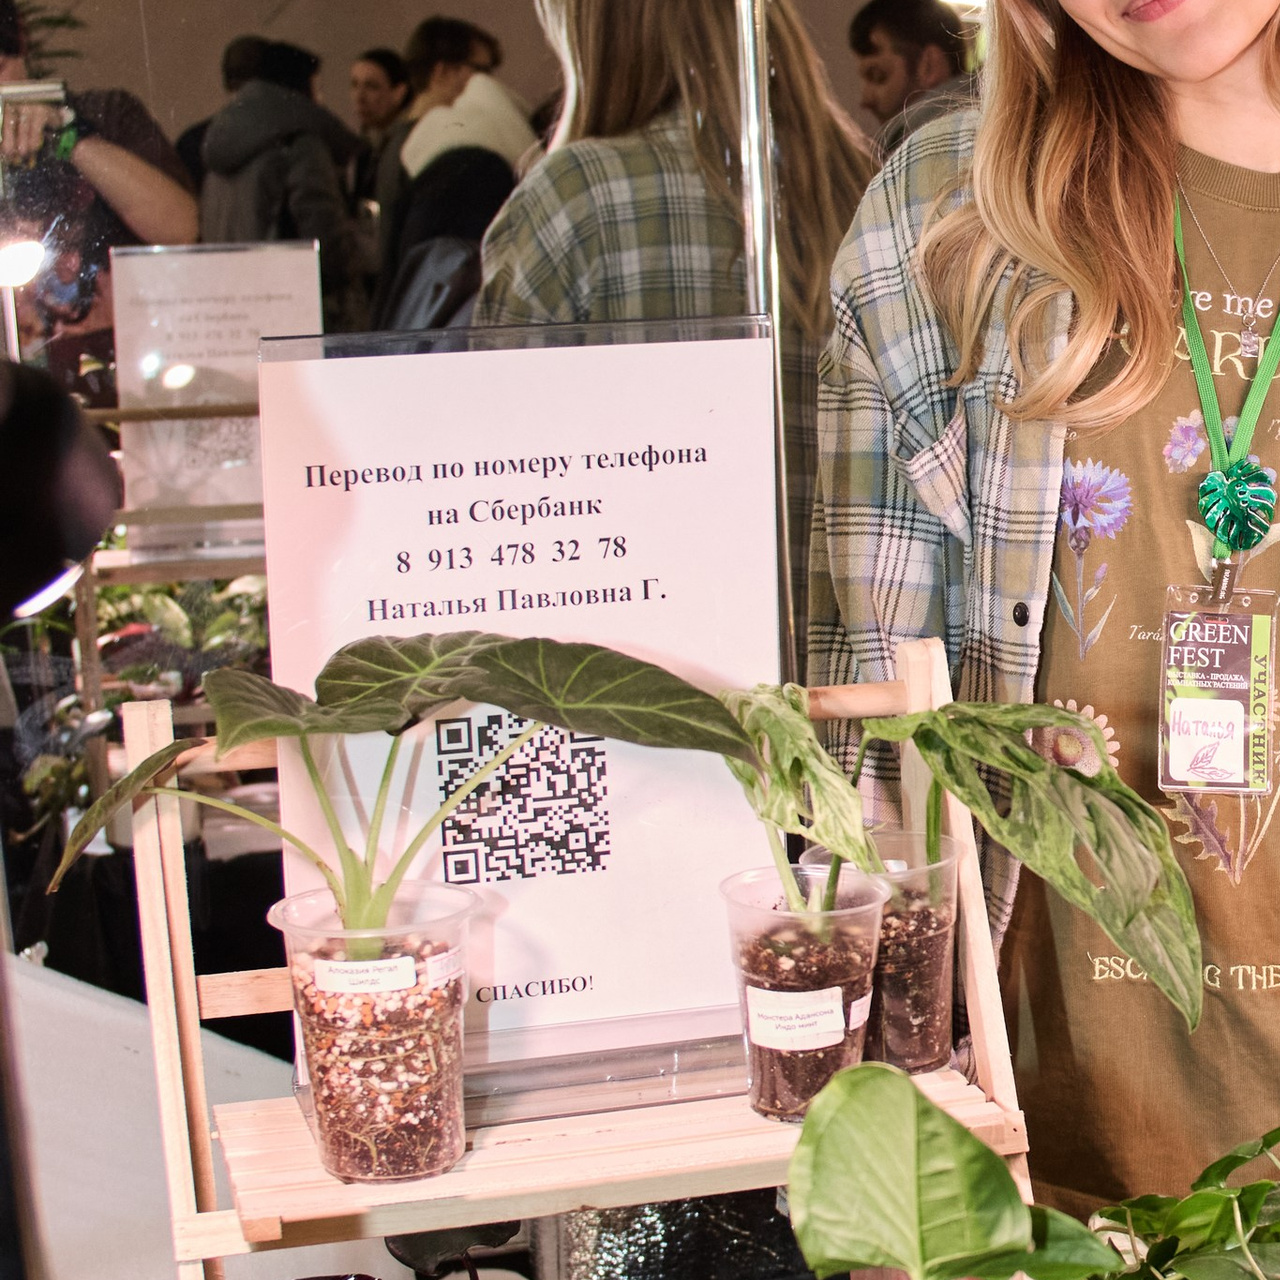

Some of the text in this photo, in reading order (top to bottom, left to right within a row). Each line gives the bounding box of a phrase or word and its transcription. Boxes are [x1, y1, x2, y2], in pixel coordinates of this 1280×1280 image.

[1223, 293, 1273, 319] me
[304, 444, 708, 492] Перевод по номеру телефона
[427, 495, 603, 526] на Сбербанк
[396, 535, 627, 574] 8 913 478 32 78
[366, 577, 667, 622] Наталья Павловна Г.
[1128, 624, 1167, 642] Tará
[1169, 621, 1251, 645] GREEN
[1168, 646, 1225, 668] FEST
[1167, 671, 1206, 680] ВЫСТАВКА
[1210, 672, 1245, 682] ПРОДАЖА
[1167, 679, 1249, 690] КОМНАТНЫХ РАСТЕНИЙ
[1252, 654, 1268, 784] УЧАСТНИК
[475, 974, 594, 1004] СПАСИБО!
